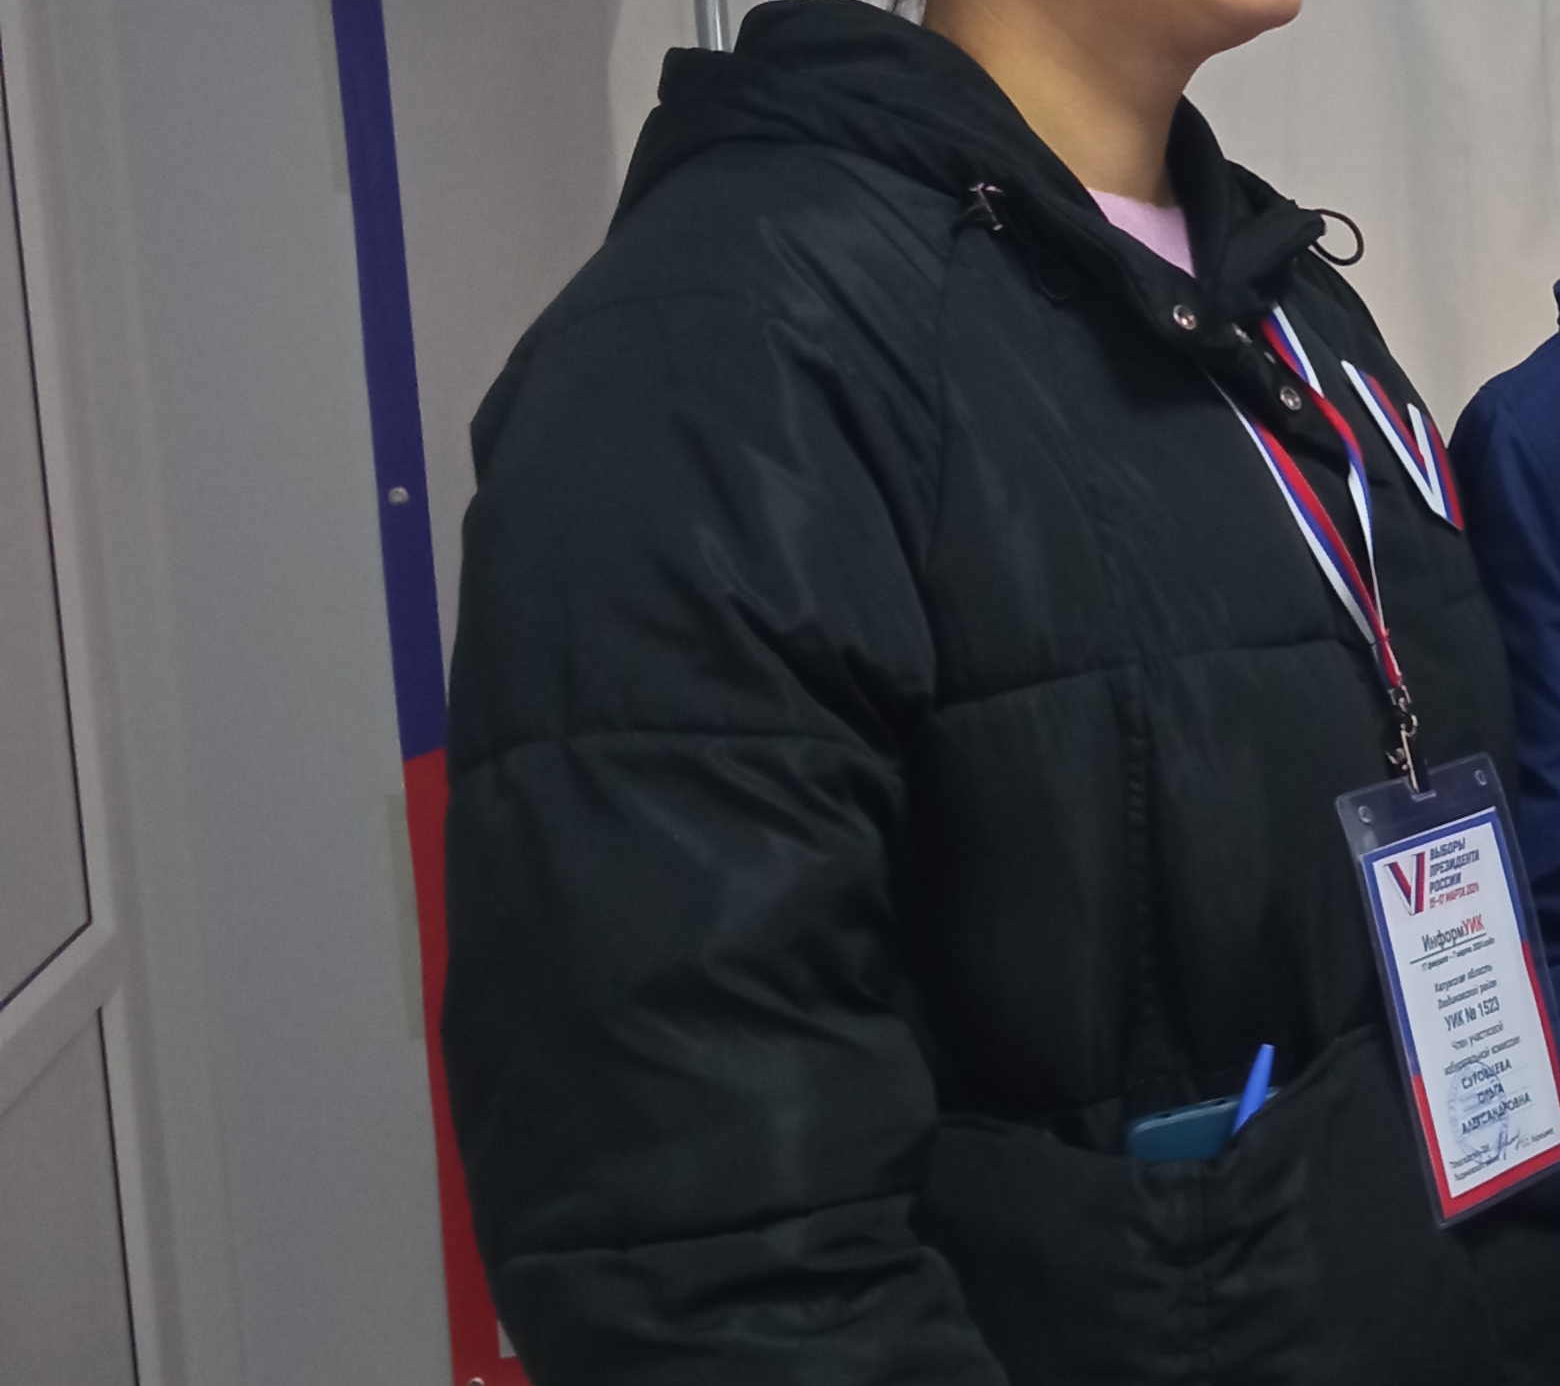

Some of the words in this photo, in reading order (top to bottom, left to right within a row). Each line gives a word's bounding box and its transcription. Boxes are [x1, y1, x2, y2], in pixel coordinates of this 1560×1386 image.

[1430, 837, 1465, 861] ВЫБОРЫ
[1430, 849, 1480, 878] ПРЕЗИДЕНТА
[1430, 872, 1462, 894] РОССИИ
[1422, 914, 1485, 952] ИнформУИК
